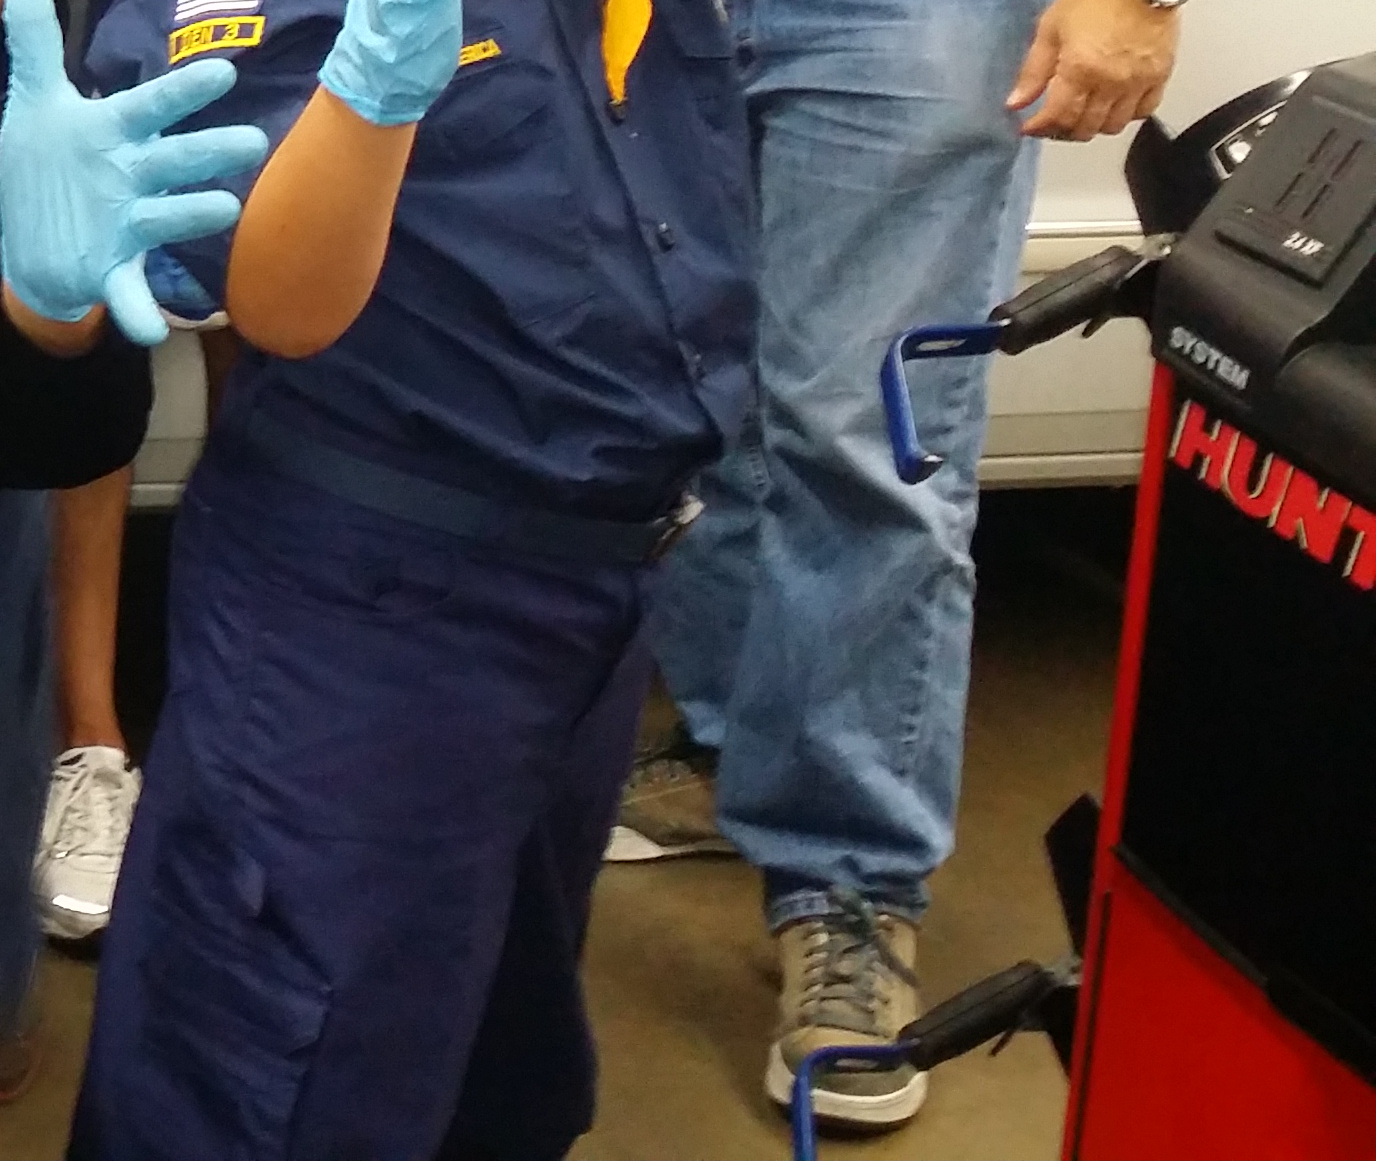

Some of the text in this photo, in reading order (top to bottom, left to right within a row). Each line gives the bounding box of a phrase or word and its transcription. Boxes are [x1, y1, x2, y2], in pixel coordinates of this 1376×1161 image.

[179, 24, 215, 52] DEN
[1170, 326, 1251, 390] SYSTEM
[1168, 399, 1376, 592] HUNT
